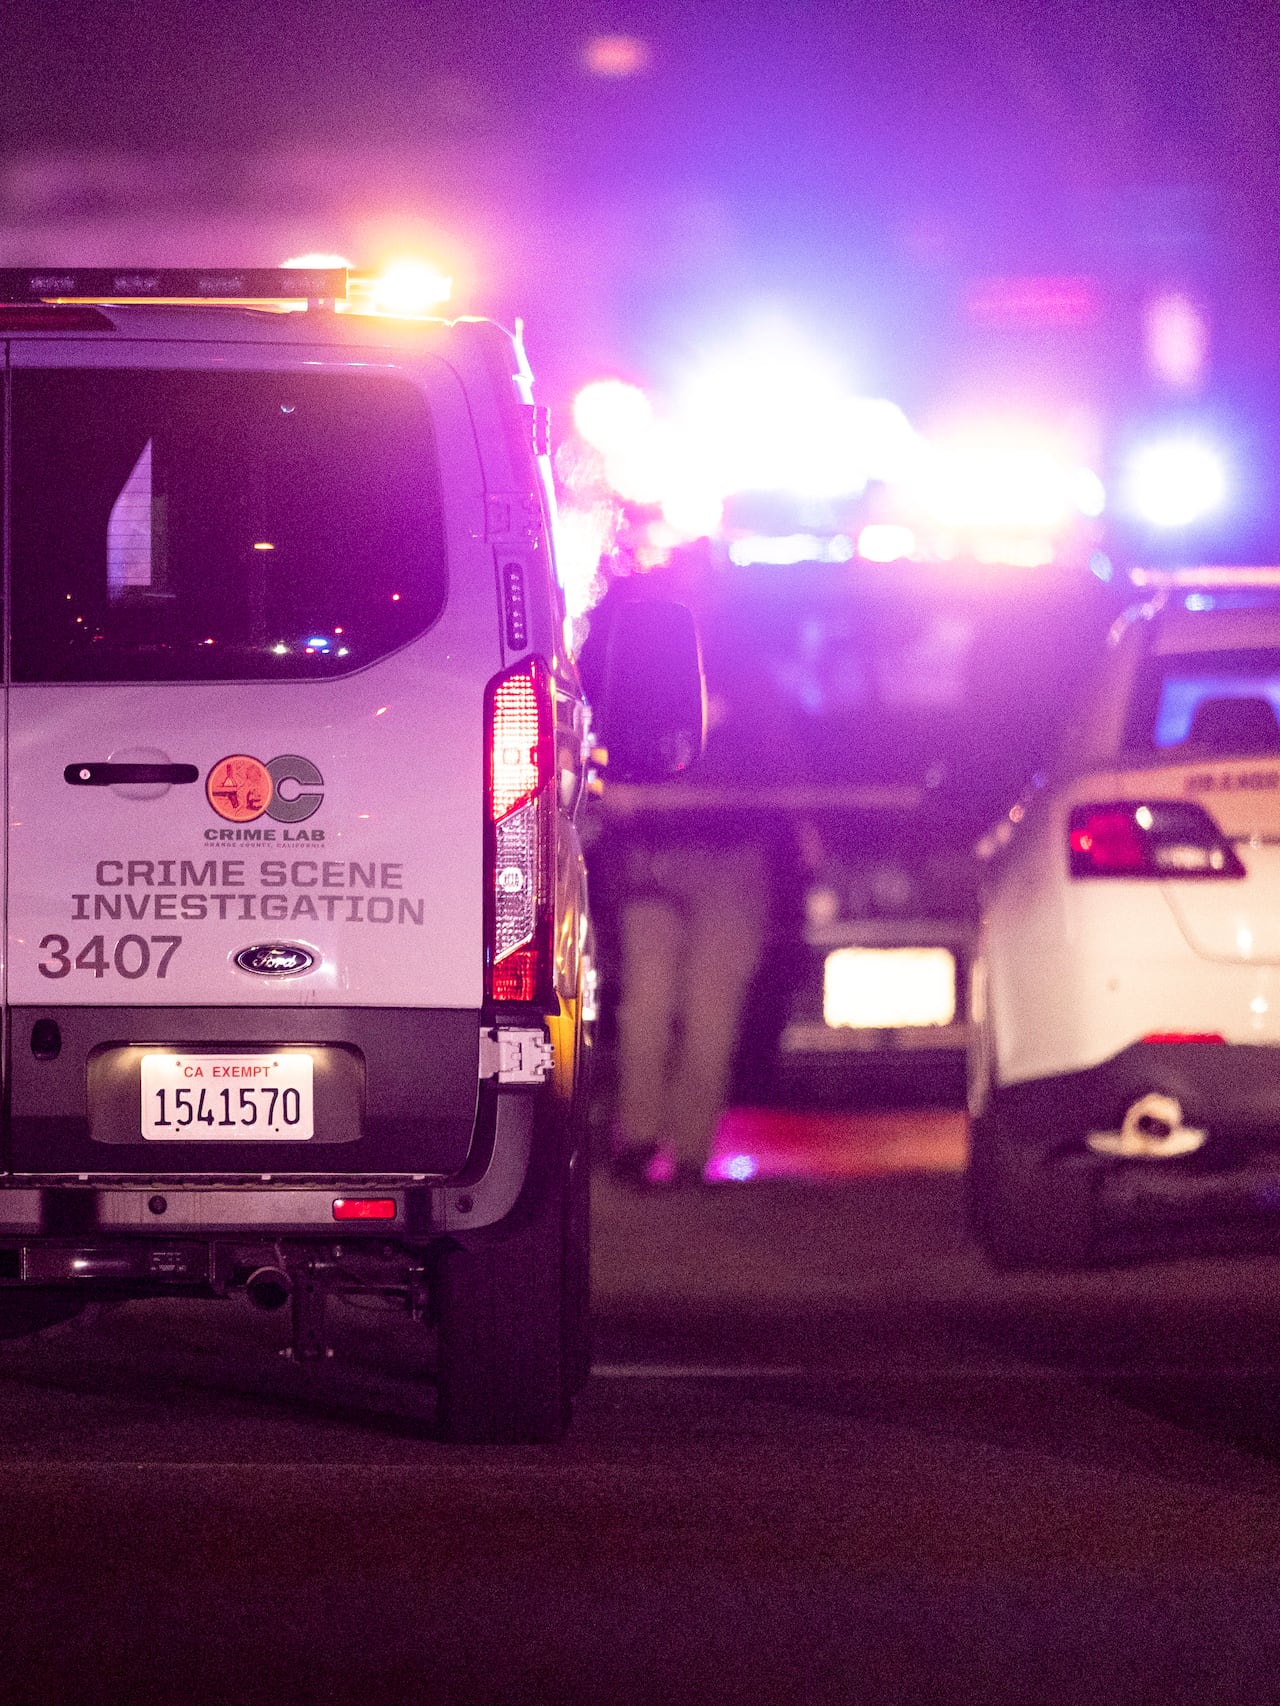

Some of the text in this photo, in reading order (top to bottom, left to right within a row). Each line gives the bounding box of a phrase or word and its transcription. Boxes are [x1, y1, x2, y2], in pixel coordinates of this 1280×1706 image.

[203, 829, 326, 841] CRIME LAB
[96, 860, 404, 890] CRIME SCENE
[71, 894, 425, 925] INVESTIGATION
[38, 934, 183, 979] 3407
[252, 949, 297, 969] Ford
[183, 1066, 271, 1078] CA EXEMPT
[154, 1087, 301, 1126] 1541570
